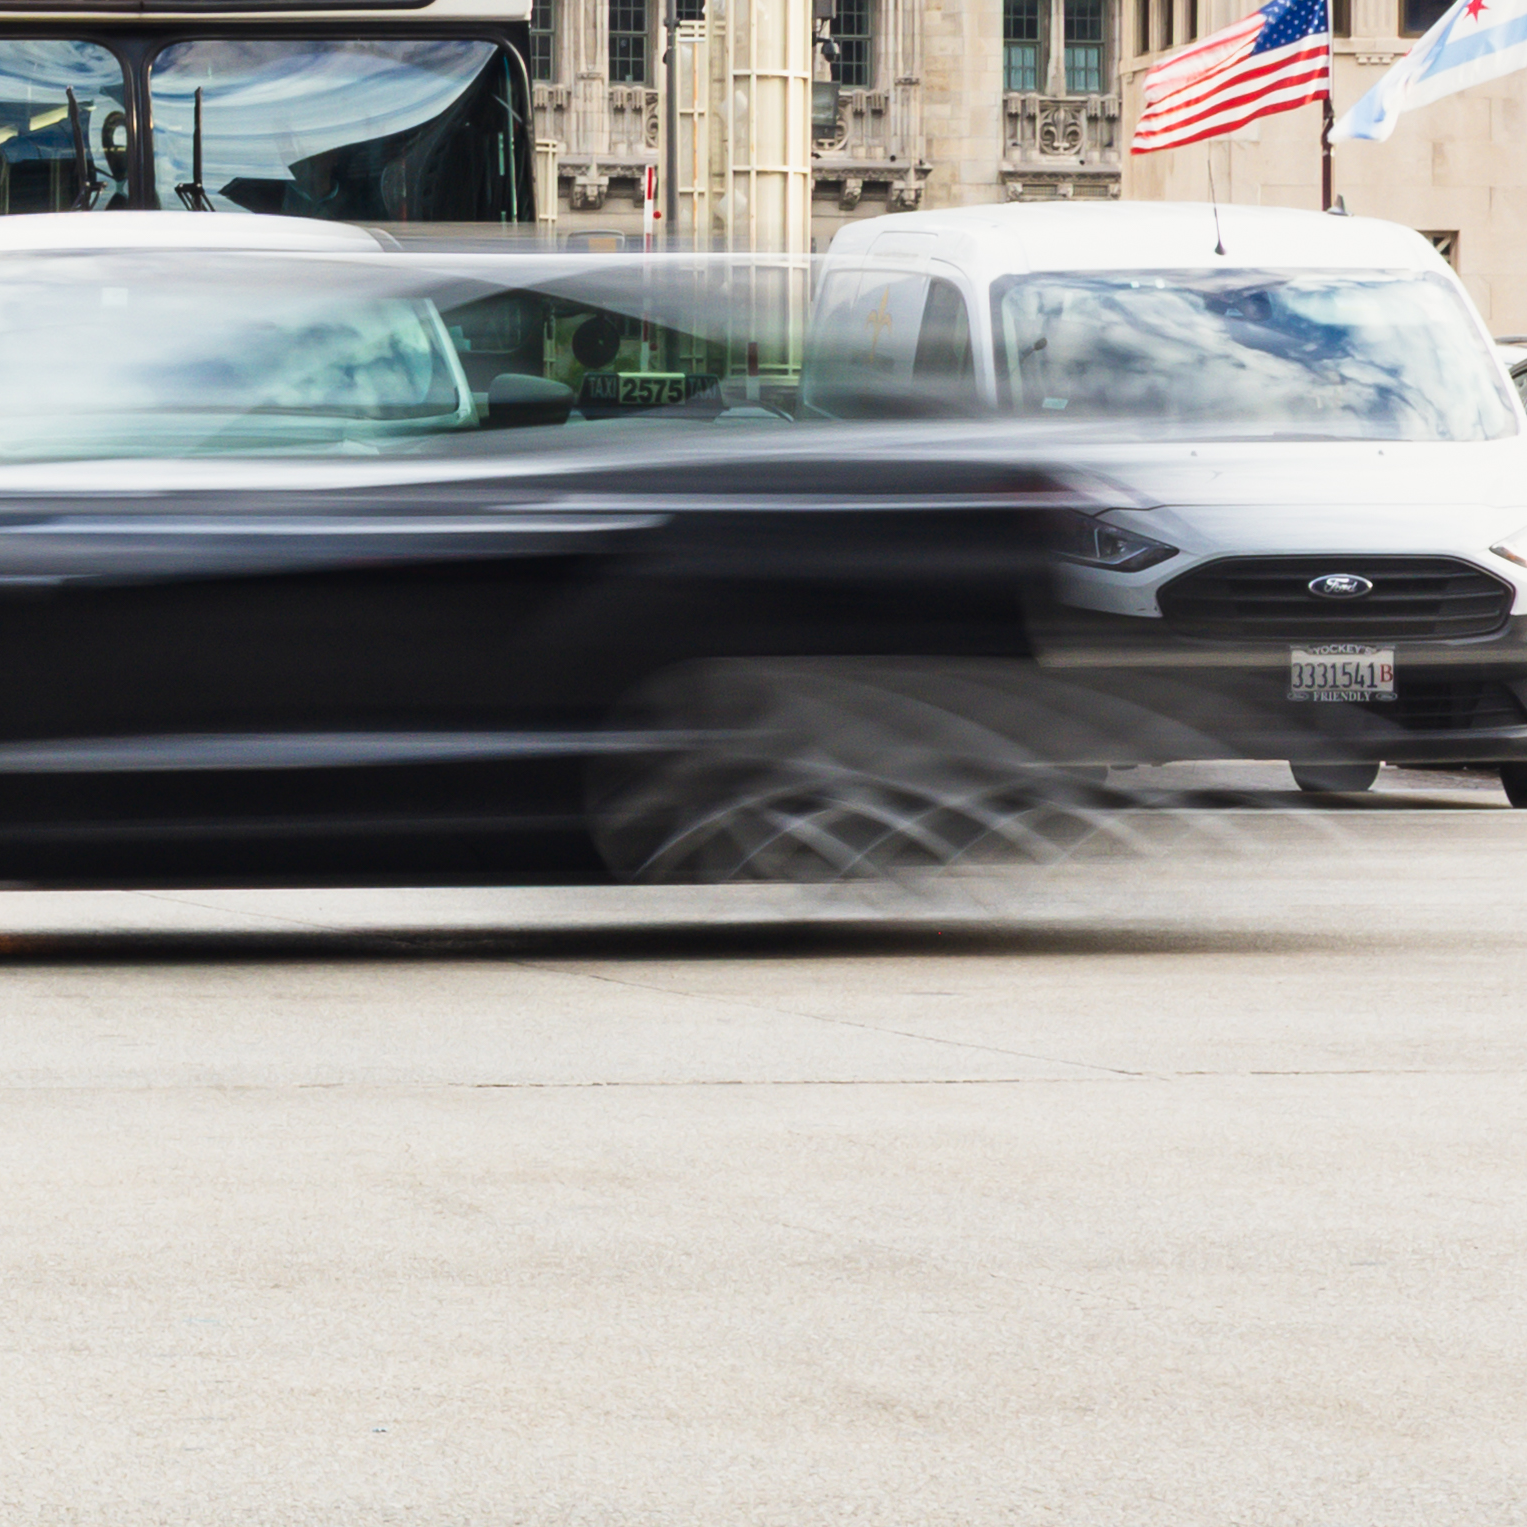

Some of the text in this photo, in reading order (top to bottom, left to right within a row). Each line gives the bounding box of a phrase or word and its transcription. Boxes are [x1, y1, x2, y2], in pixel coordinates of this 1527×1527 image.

[587, 377, 617, 399] TAXI
[621, 378, 684, 404] 2575
[1324, 577, 1359, 593] Ford
[1292, 662, 1394, 689] 3331541 B
[1313, 692, 1372, 702] FRIENDLY
